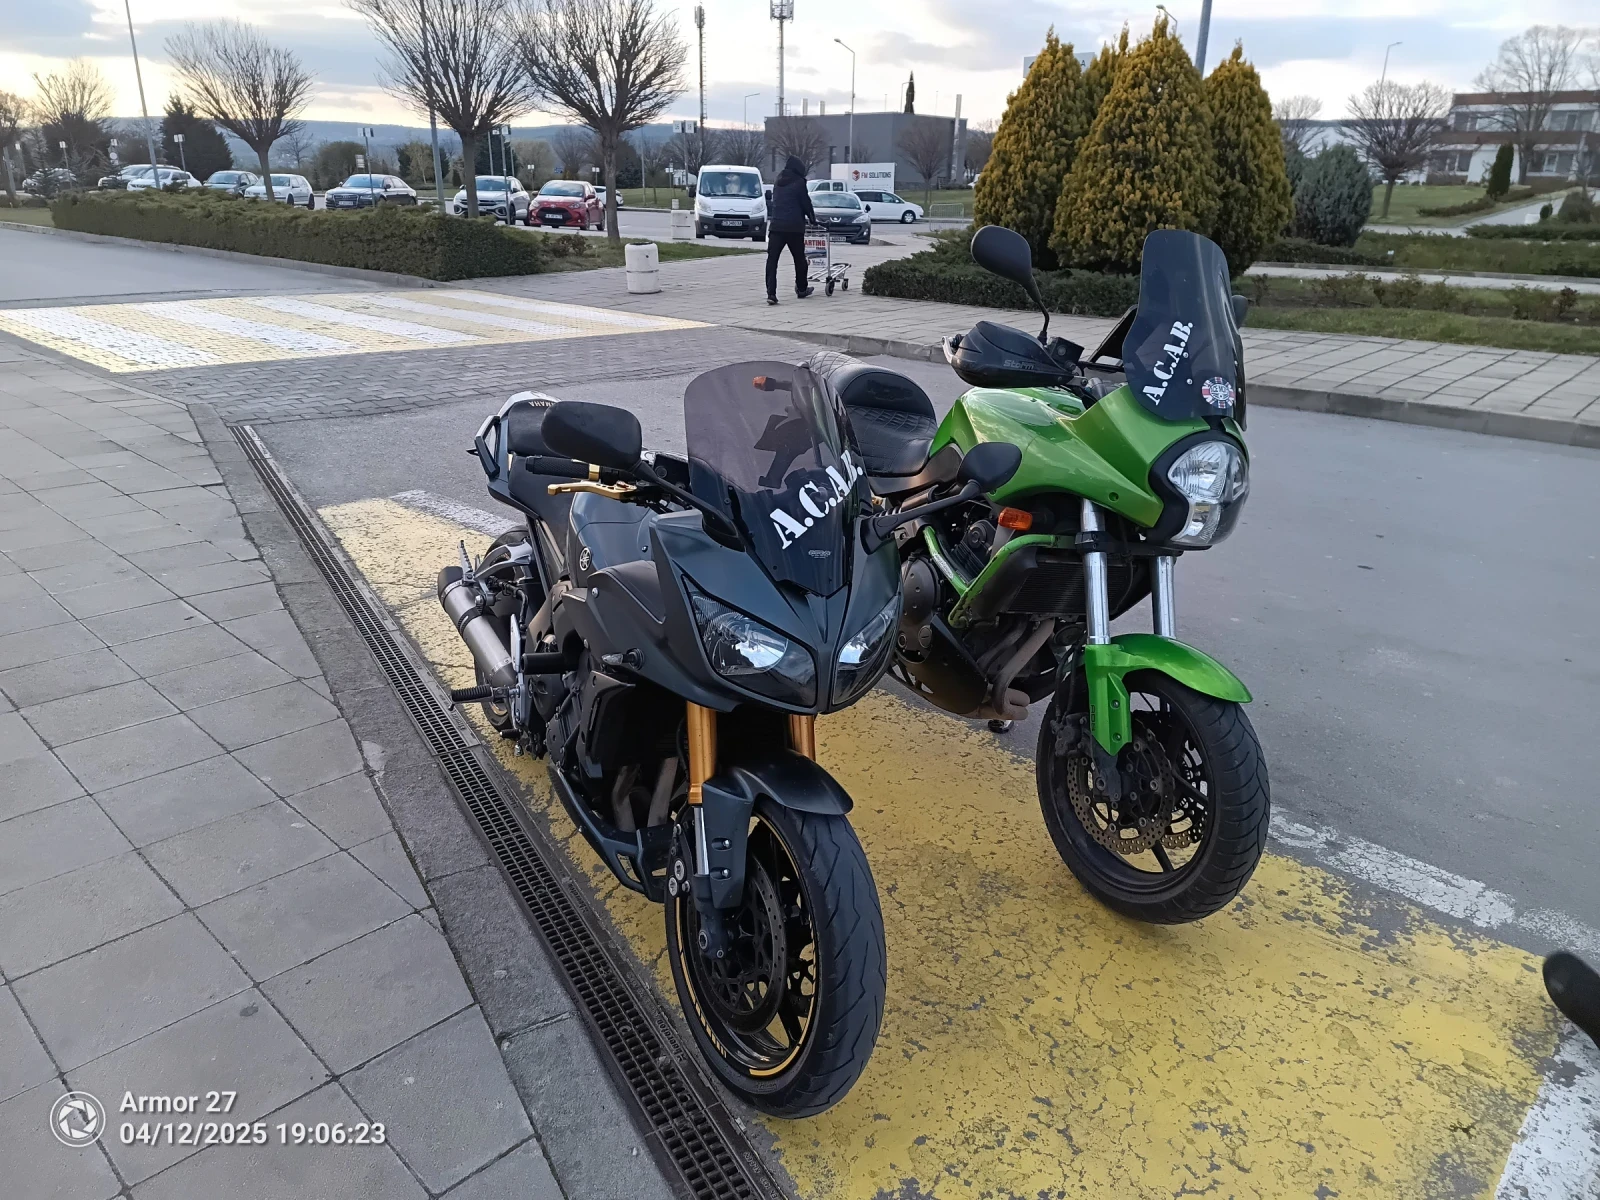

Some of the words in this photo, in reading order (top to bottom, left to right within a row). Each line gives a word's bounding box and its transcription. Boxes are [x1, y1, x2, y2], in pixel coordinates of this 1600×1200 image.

[869, 171, 892, 179] SOLUTIONS
[804, 239, 826, 247] ARTING
[1003, 360, 1034, 370] Storm
[1142, 321, 1194, 406] A.C.A.B.
[769, 449, 864, 550] A.C.A.B.
